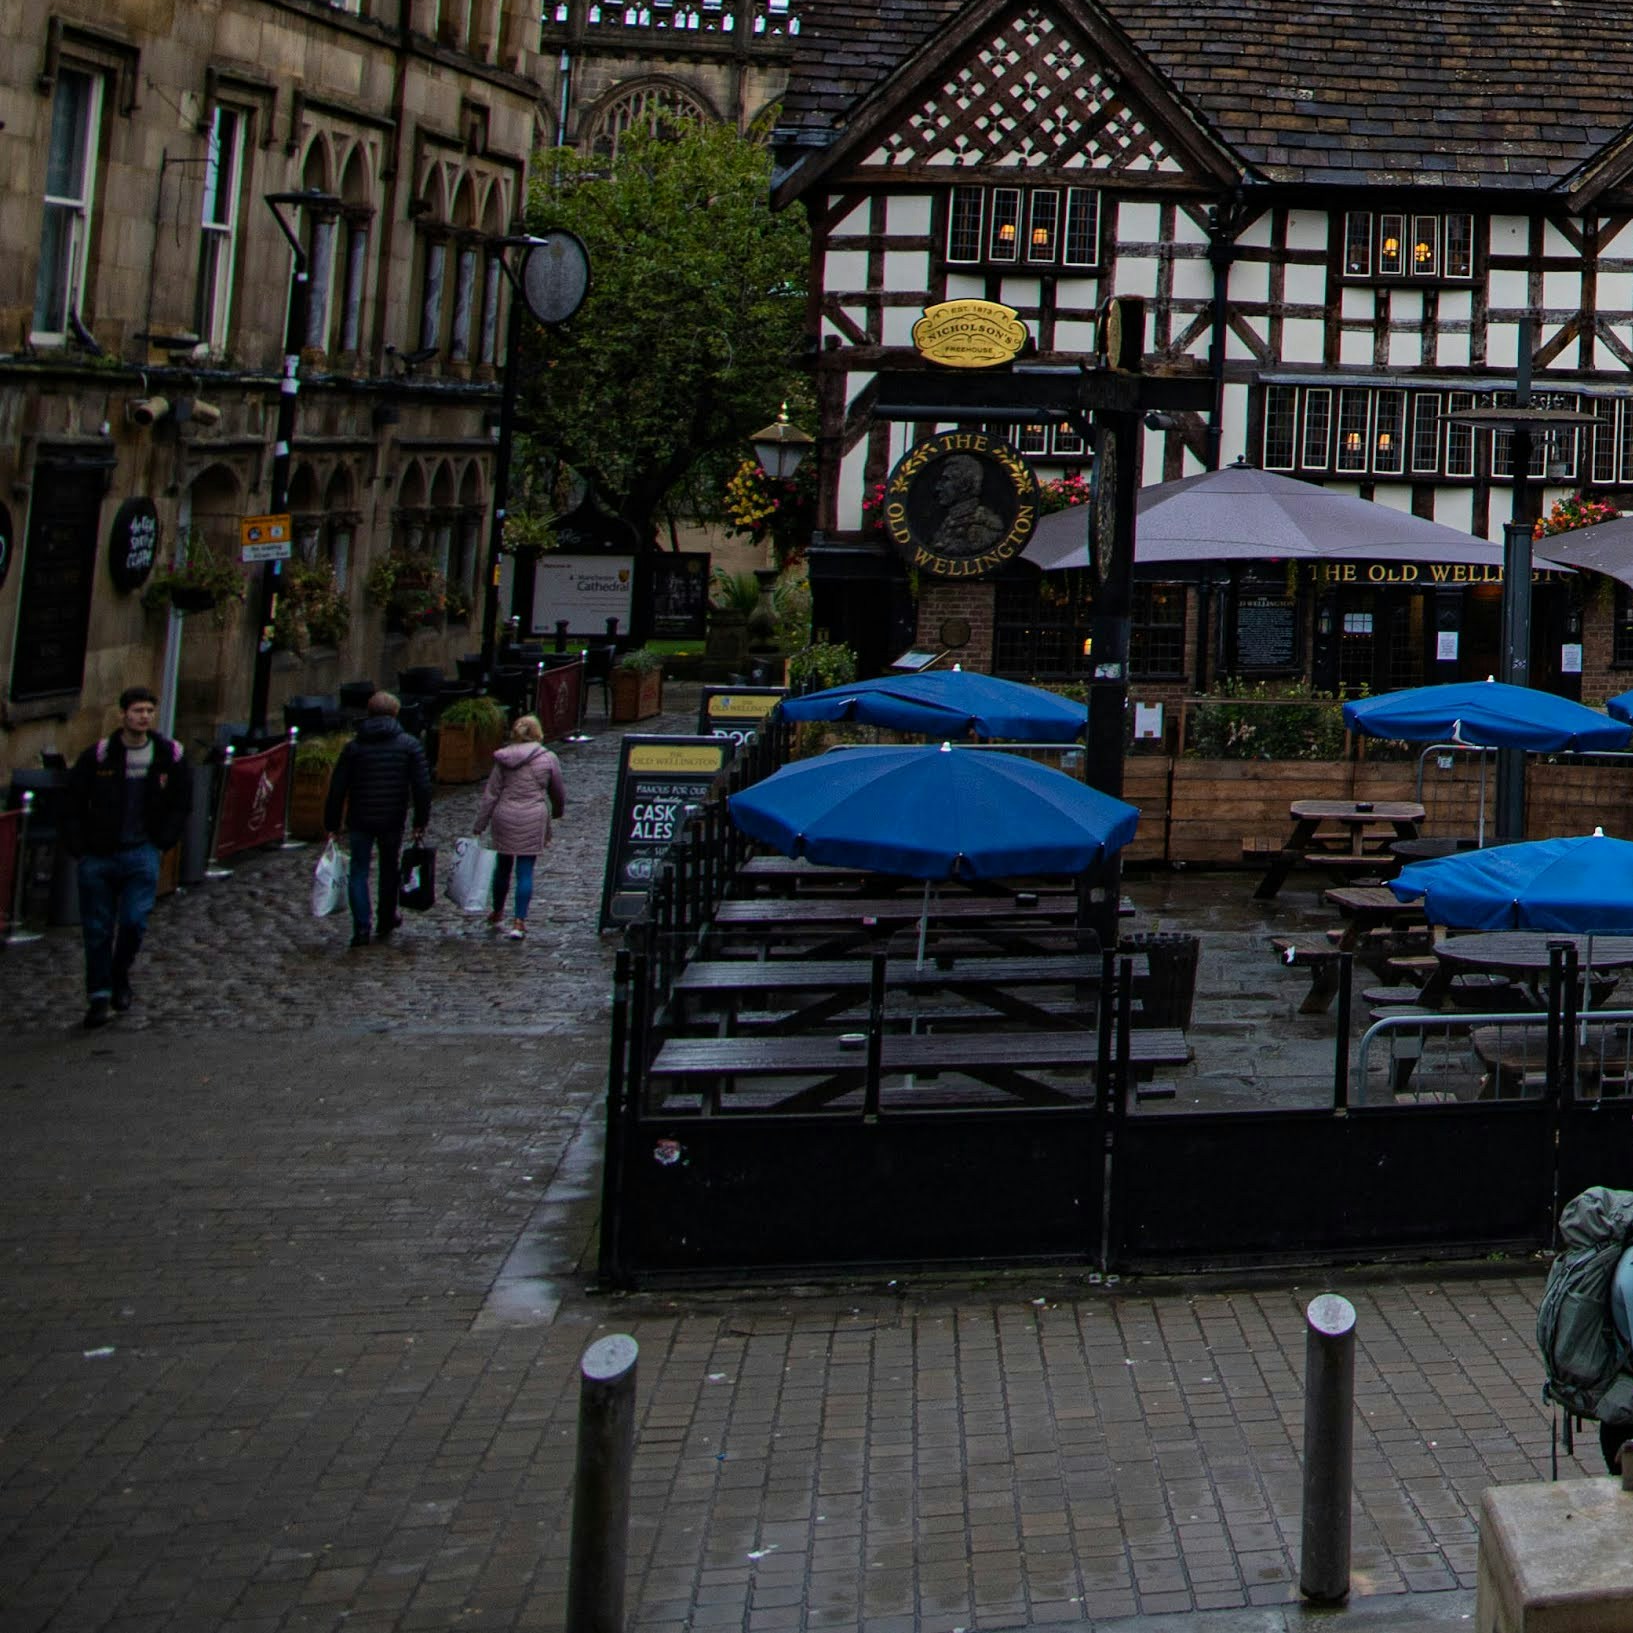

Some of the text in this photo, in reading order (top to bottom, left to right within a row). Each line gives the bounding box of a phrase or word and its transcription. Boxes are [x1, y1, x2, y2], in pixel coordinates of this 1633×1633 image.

[928, 323, 1013, 344] NICHOLSON'S
[945, 346, 993, 354] FREEHOUSE
[939, 433, 990, 453] THE
[887, 502, 911, 544] OLD
[914, 505, 1034, 576] WELLINGTON
[1308, 564, 1357, 582] THE
[1368, 564, 1418, 582] OLD
[577, 581, 629, 592] Cathedral
[633, 757, 717, 766] OLD WELLINGTON
[636, 784, 670, 794] FAMOUS
[671, 785, 688, 795] FOR
[632, 803, 677, 822] CASK
[630, 821, 673, 839] ALES
